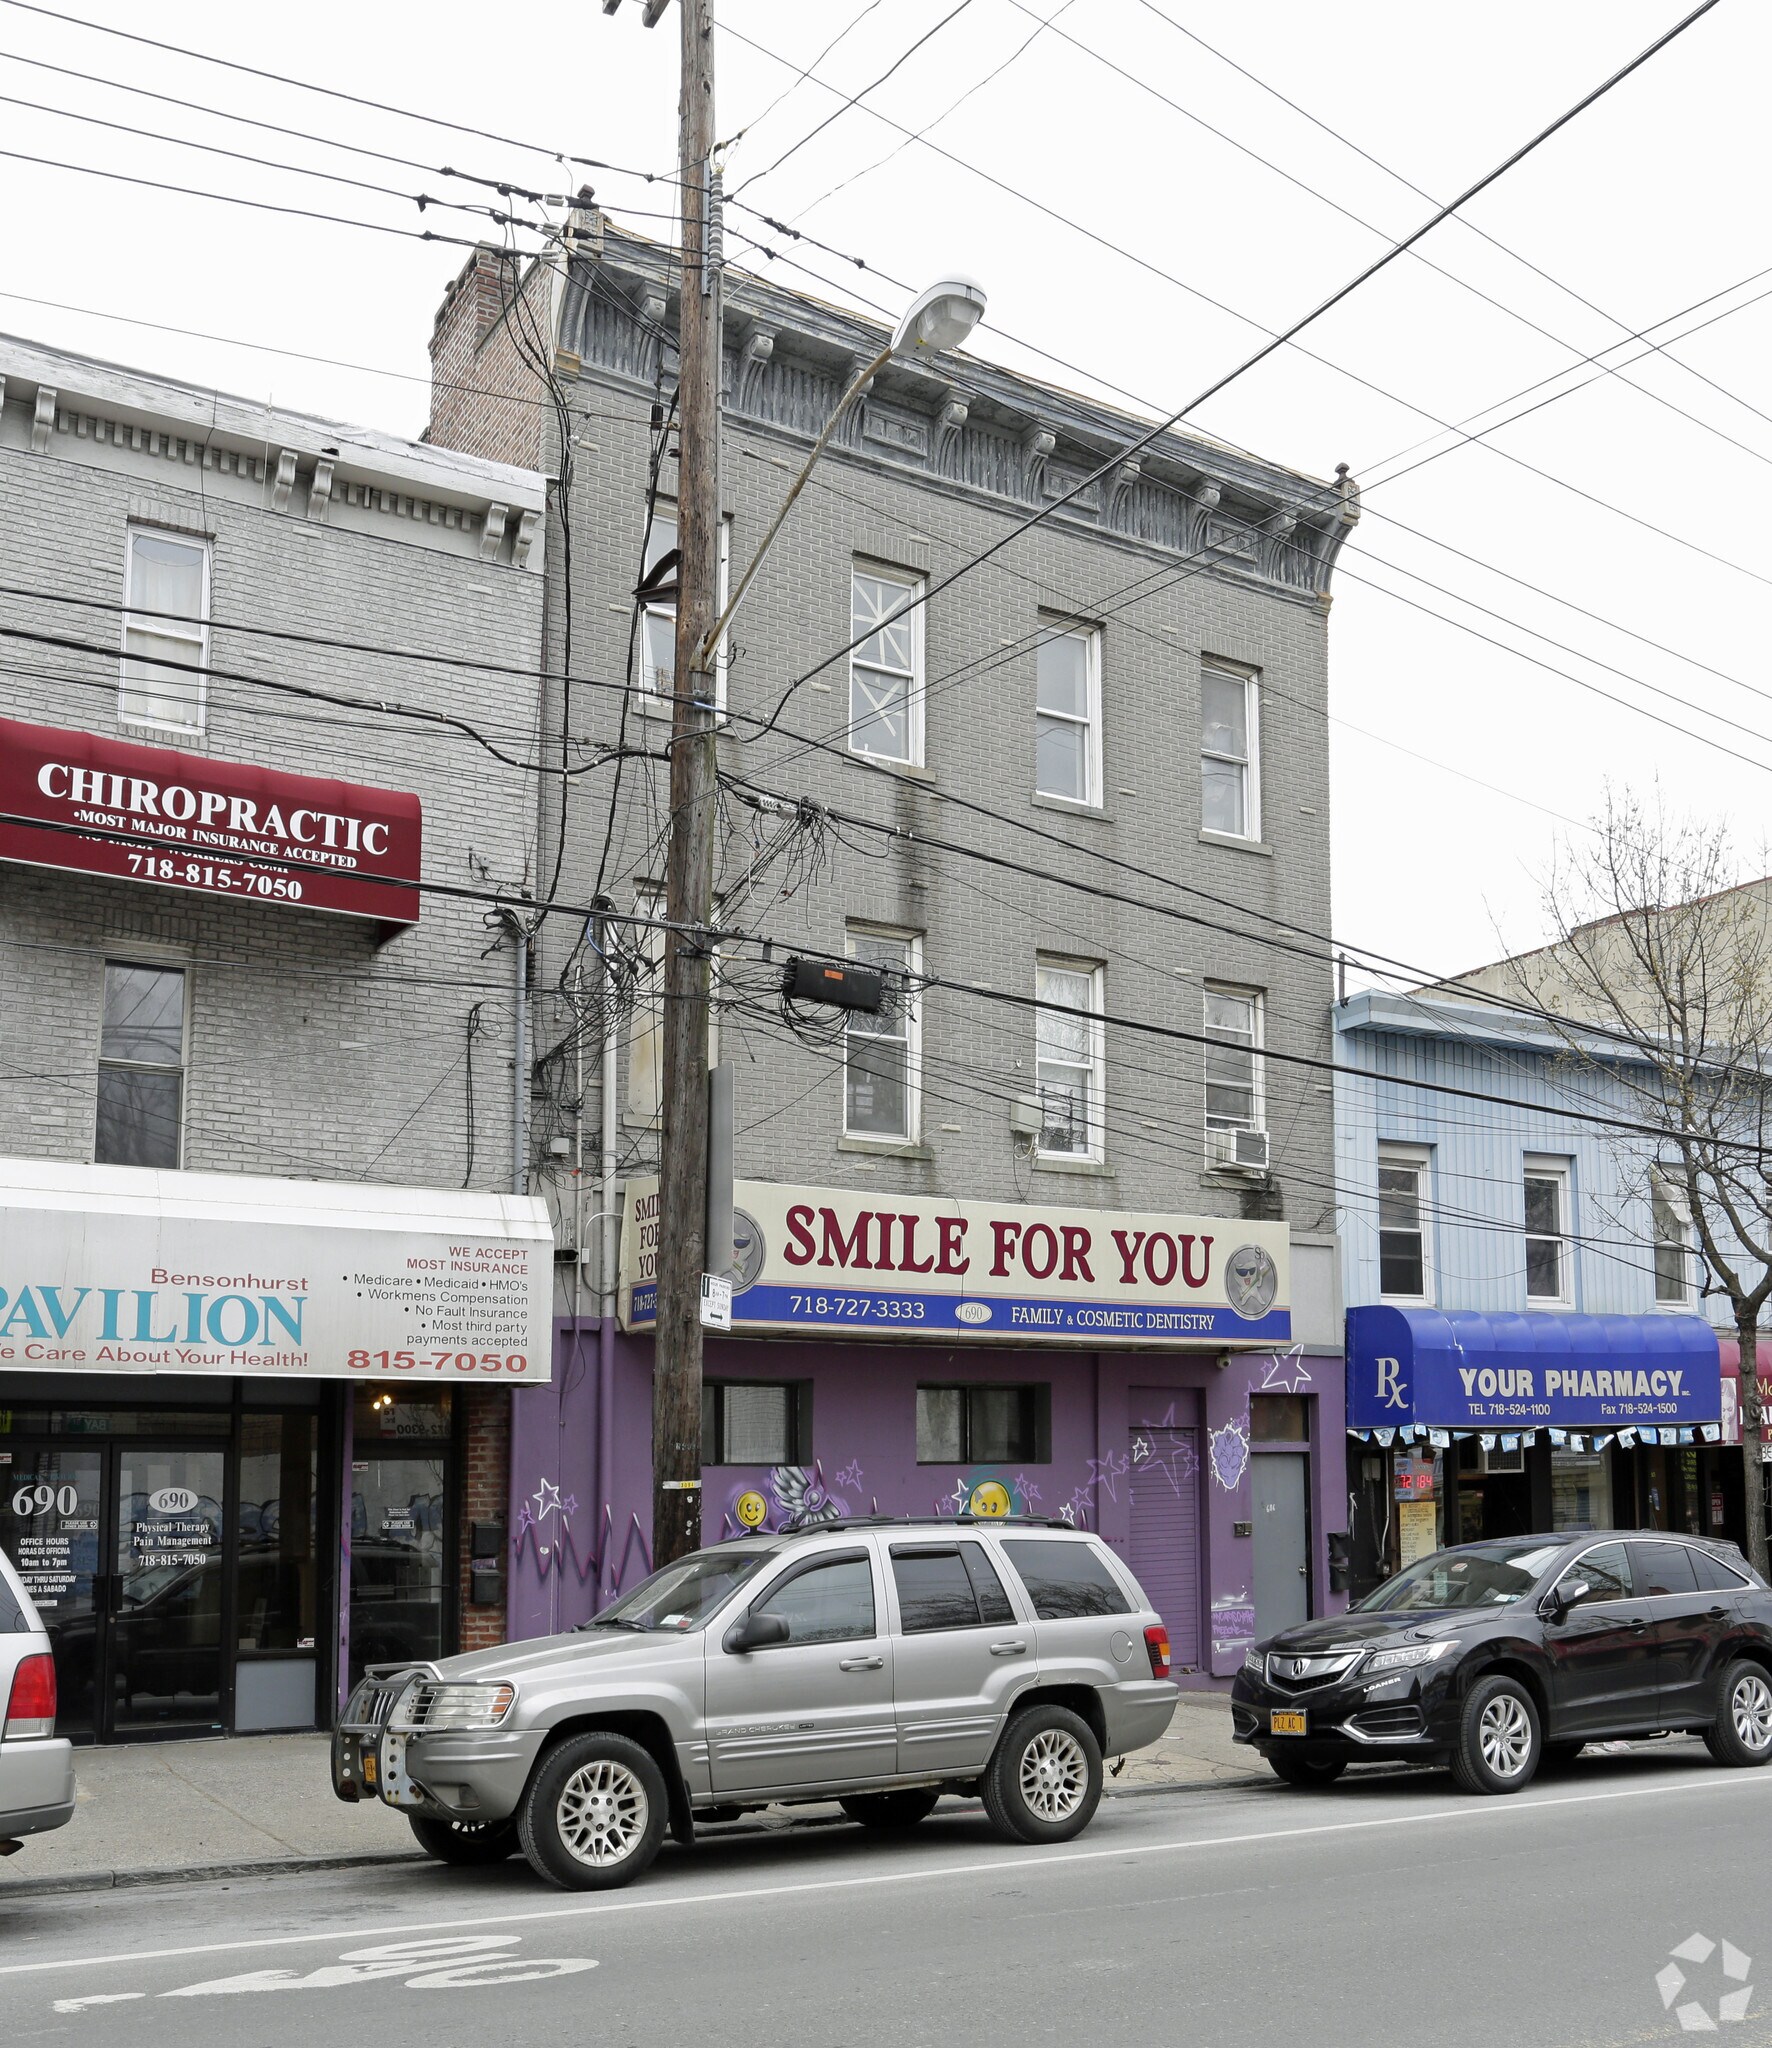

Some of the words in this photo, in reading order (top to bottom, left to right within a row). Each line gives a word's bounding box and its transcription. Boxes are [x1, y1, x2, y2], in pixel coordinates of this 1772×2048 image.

[37, 763, 389, 855] CHIROPRACTIC
[79, 809, 127, 829] MOST
[131, 819, 187, 839] MAJOR
[192, 829, 279, 856] INSURANCE
[283, 846, 357, 869] ACCEPTED
[127, 853, 303, 900] 718-815-7050
[635, 1193, 660, 1222] SMIL
[449, 1246, 470, 1257] WE
[475, 1248, 528, 1260] ACCEPT
[783, 1204, 970, 1275] SMILE
[989, 1221, 1095, 1282] FOR
[1111, 1230, 1214, 1288] YOU
[407, 1258, 446, 1270] MOST
[450, 1260, 528, 1275] INSURANCE
[151, 1268, 308, 1291] Bensonhurst
[354, 1273, 413, 1287] Medicare
[424, 1276, 479, 1290] Medicaid
[489, 1280, 528, 1291] HMO's
[368, 1288, 436, 1302] Workmens
[440, 1291, 528, 1306] Compensation
[415, 1305, 433, 1316] No
[437, 1305, 466, 1318] Fault
[469, 1307, 528, 1319] Insurance
[789, 1296, 925, 1319] 718-727-3333
[965, 1306, 983, 1320] 690
[1011, 1306, 1064, 1325] FAMILY
[1066, 1315, 1074, 1326] &
[1076, 1309, 1143, 1329] COSMETIC
[1146, 1312, 1215, 1330] DENTISTRY
[432, 1319, 463, 1331] Most
[466, 1320, 492, 1332] third
[495, 1322, 528, 1336] party
[406, 1334, 467, 1347] payments
[471, 1336, 528, 1349] accepted
[24, 1343, 86, 1361] Care
[96, 1346, 170, 1364] About
[175, 1348, 226, 1366] Your
[230, 1350, 308, 1367] Health!
[347, 1350, 528, 1373] 815-7050
[1458, 1368, 1534, 1397] YOUR
[1545, 1369, 1683, 1397] PHARMACY
[1468, 1403, 1486, 1415] TEL
[1489, 1403, 1551, 1416] 718-524-1100
[1601, 1403, 1617, 1415] Fax
[1619, 1402, 1678, 1415] 718-524-1500
[12, 1485, 77, 1516] 690
[158, 1492, 189, 1508] 690
[136, 1522, 172, 1534] Physical
[175, 1522, 210, 1533] Therapy
[45, 1537, 69, 1545] HOURS
[133, 1536, 153, 1546] Pain
[157, 1536, 212, 1547] Management
[18, 1547, 37, 1555] HORAS
[21, 1558, 39, 1566] 10am
[42, 1558, 50, 1566] to
[52, 1558, 67, 1567] 7pm
[138, 1554, 207, 1566] 718-815-7050
[48, 1575, 77, 1583] SATURDAY
[43, 1585, 67, 1593] SABADO
[1363, 1676, 1401, 1693] LOANER
[716, 1727, 747, 1736] GRAND
[748, 1723, 796, 1733] CHEROKEE
[1273, 1716, 1285, 1730] PLZ
